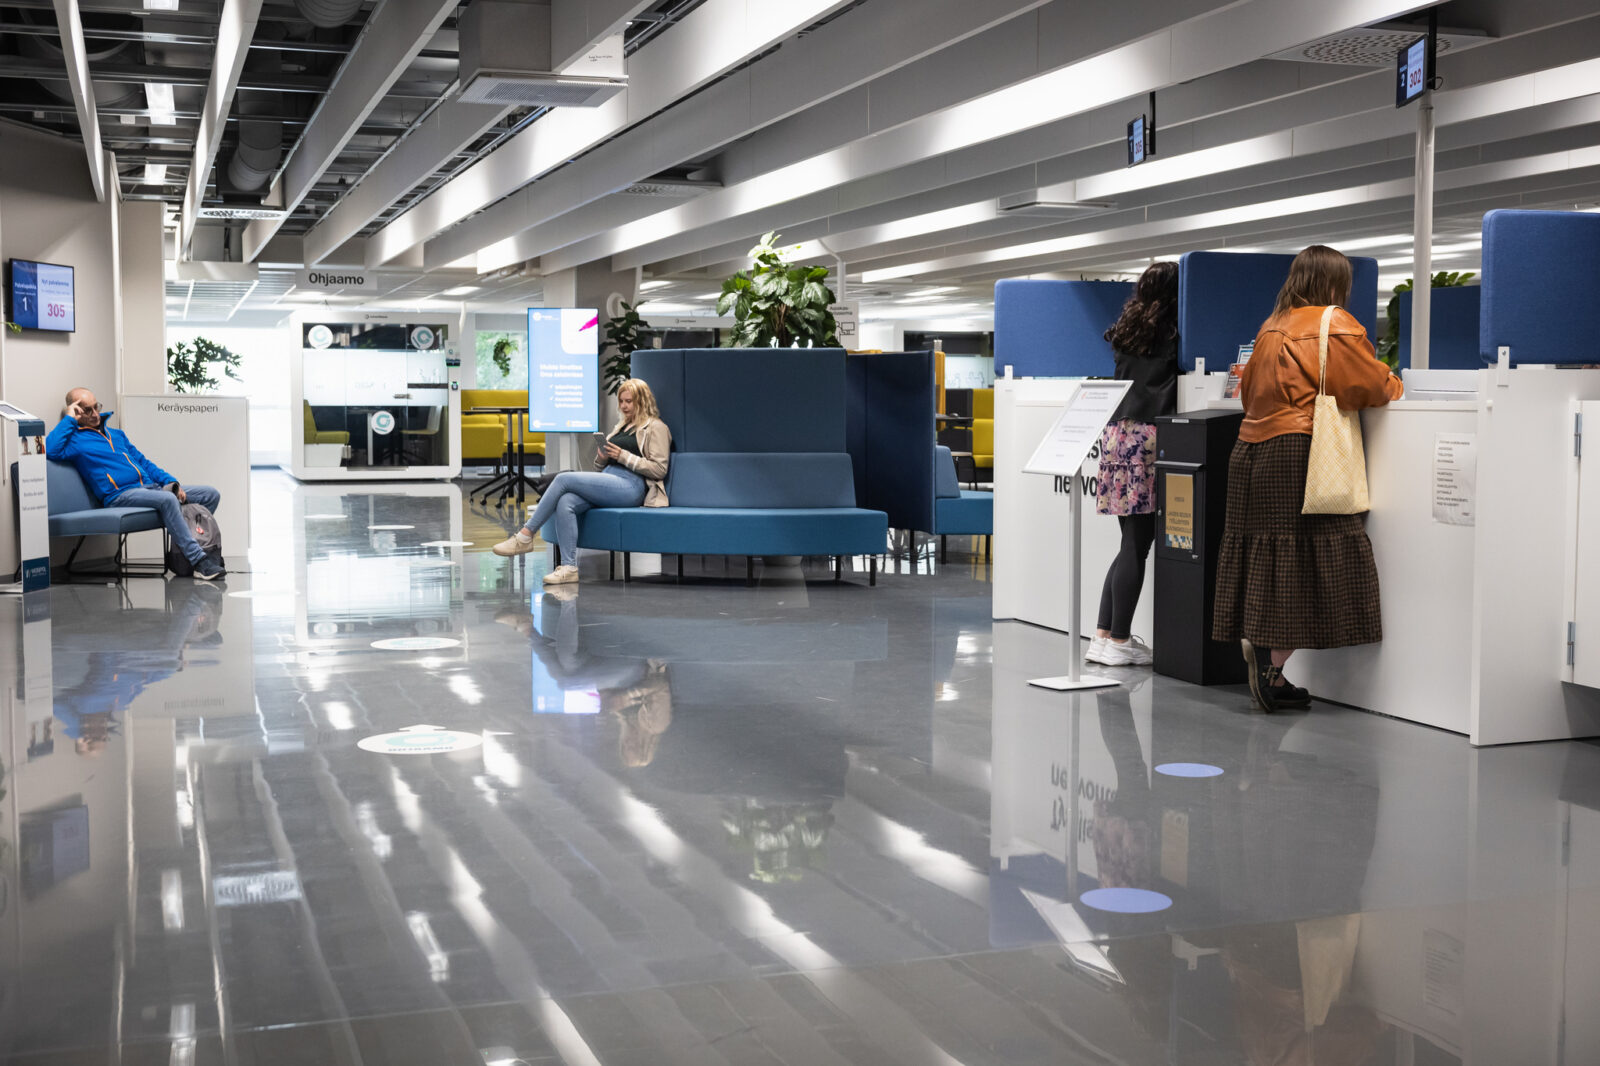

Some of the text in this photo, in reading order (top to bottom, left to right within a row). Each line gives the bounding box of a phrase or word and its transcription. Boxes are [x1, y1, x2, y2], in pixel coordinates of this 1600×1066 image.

[1401, 73, 1406, 87] 2
[1409, 68, 1421, 88] 302
[309, 272, 364, 286] Ohjaamo
[22, 296, 28, 311] 1
[48, 303, 65, 318] 305
[157, 403, 219, 414] Keräyspaperi
[1054, 475, 1098, 497] nevo
